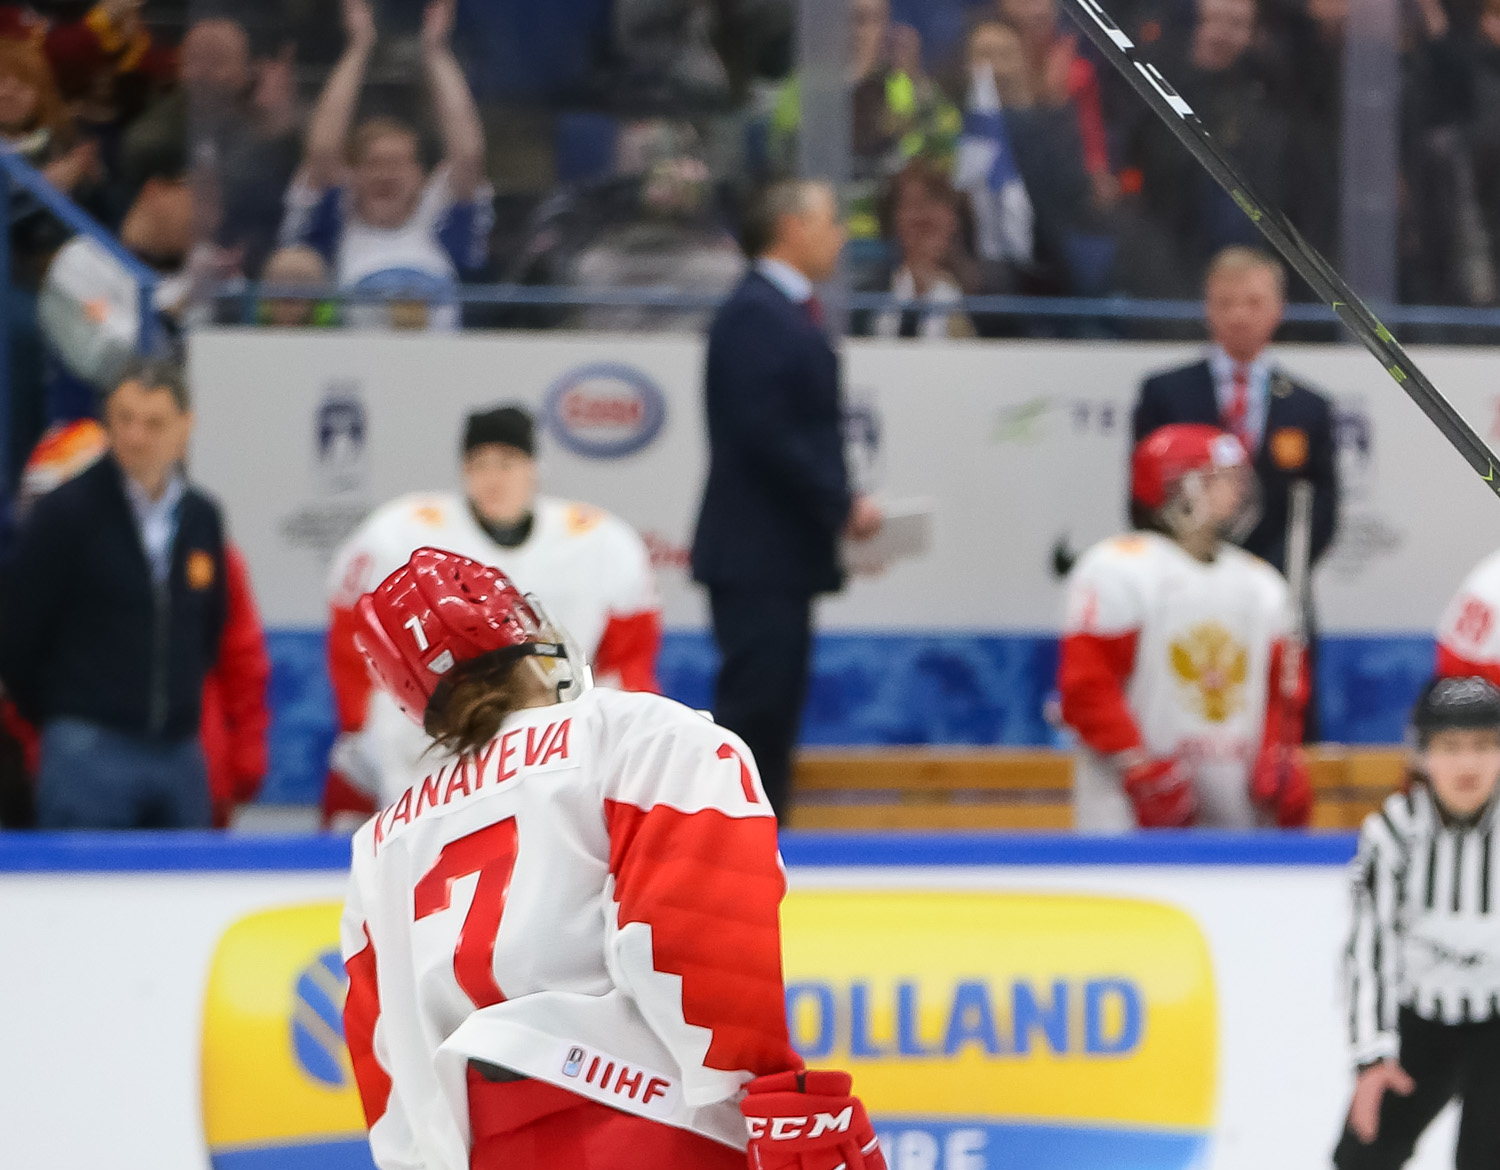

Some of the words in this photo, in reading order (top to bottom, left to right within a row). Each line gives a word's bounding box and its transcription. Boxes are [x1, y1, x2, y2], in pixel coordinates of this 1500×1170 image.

[373, 717, 574, 857] KANAYEVA
[413, 814, 519, 1010] 7
[585, 1055, 671, 1104] IIHF
[744, 1105, 854, 1141] CCM
